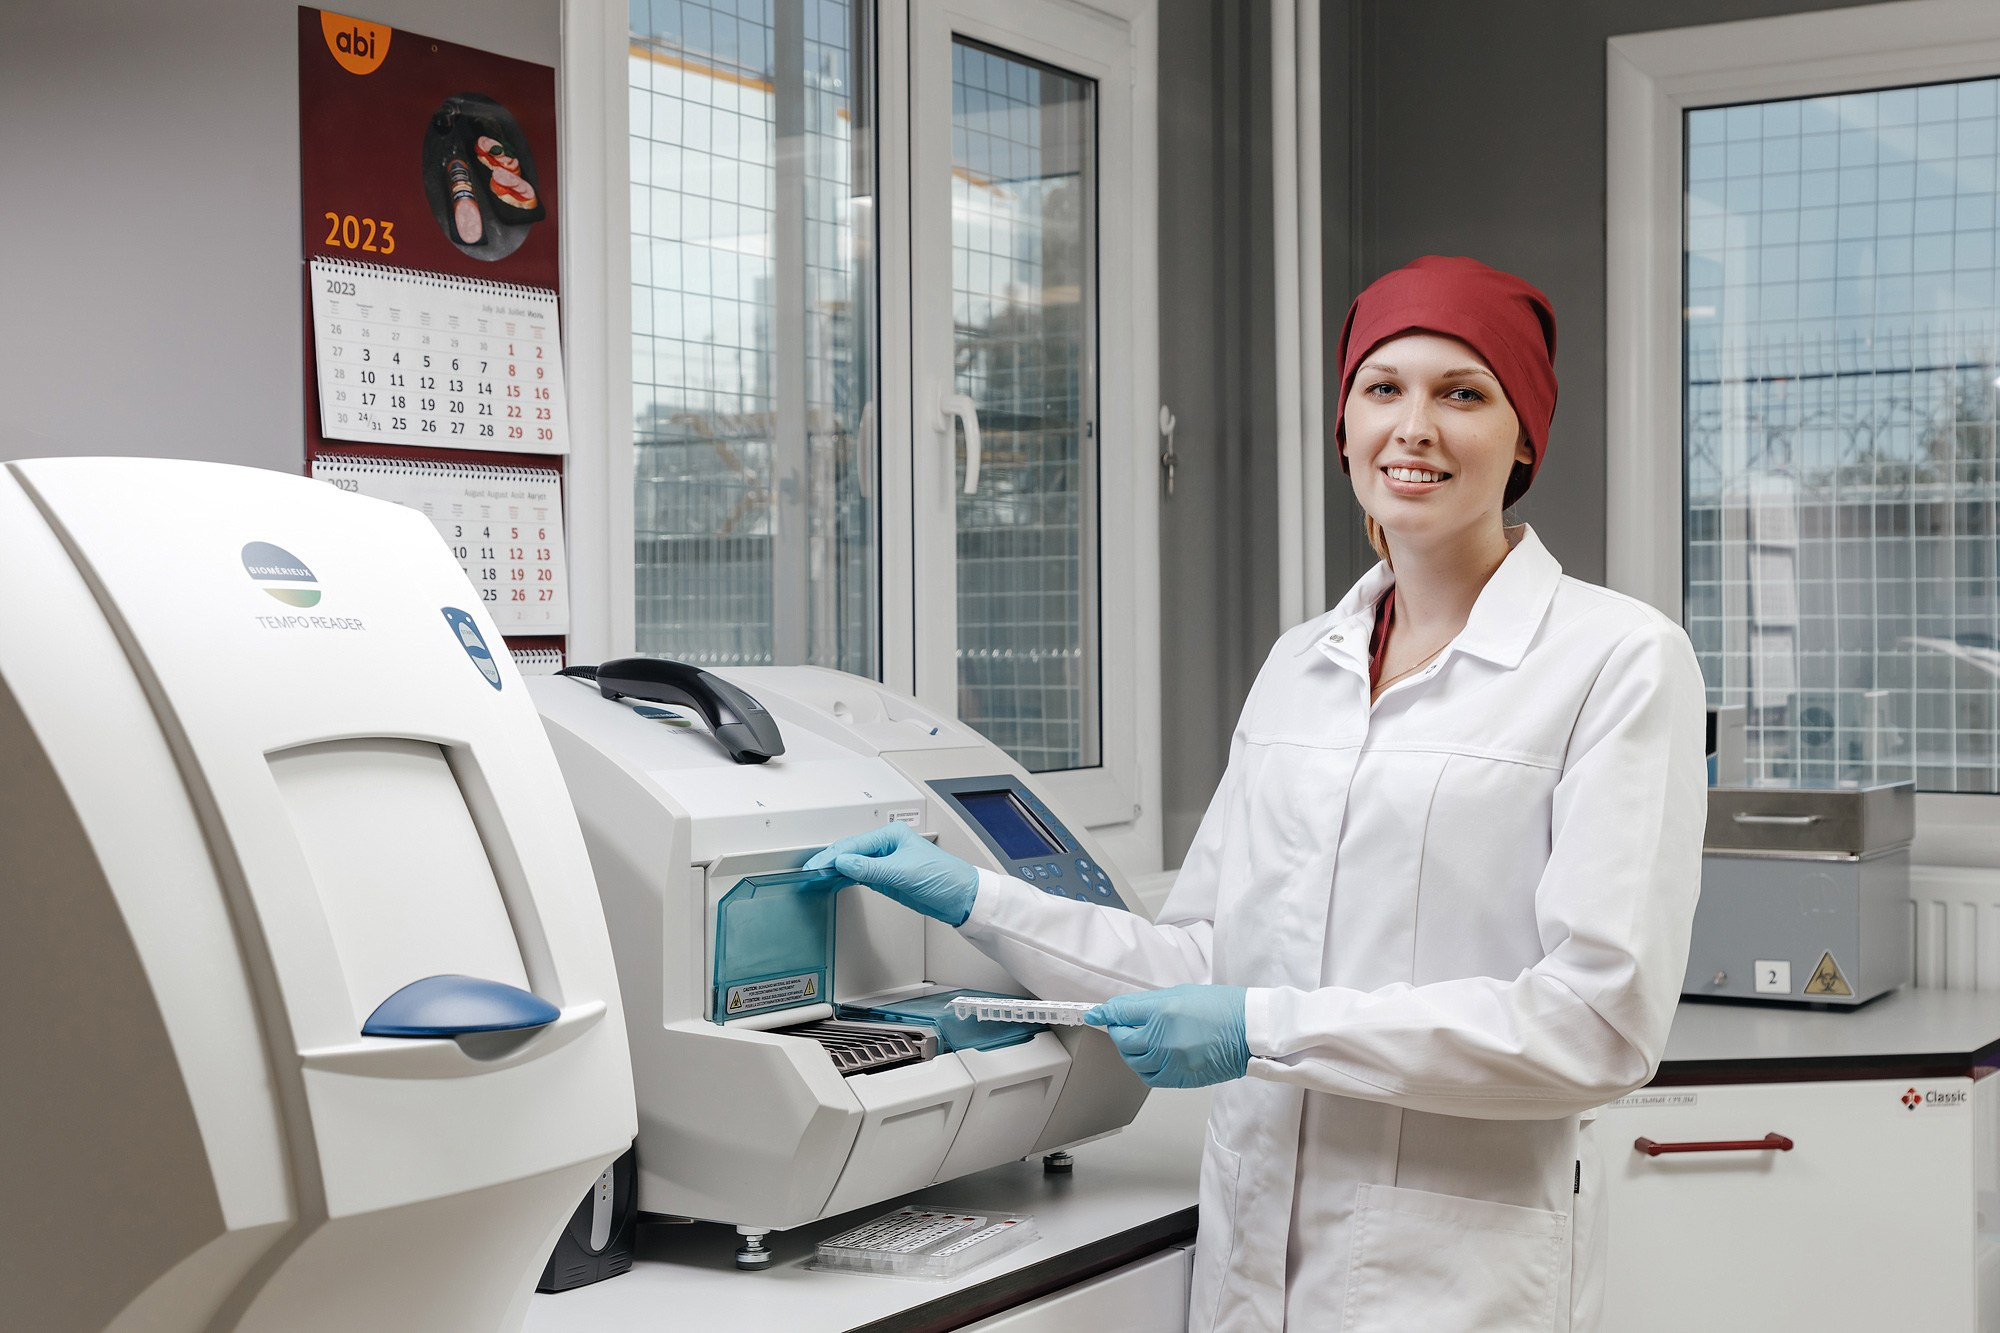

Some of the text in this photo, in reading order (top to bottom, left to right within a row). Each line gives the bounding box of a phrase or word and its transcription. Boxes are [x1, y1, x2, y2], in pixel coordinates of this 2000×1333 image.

[335, 27, 375, 59] abi
[324, 212, 395, 255] 2023
[326, 280, 356, 296] 2023
[330, 324, 343, 335] 26
[508, 344, 515, 357] 1
[535, 347, 543, 359] 2
[332, 346, 544, 380] 27 3 4 5 6 7 8 9
[334, 368, 550, 400] 28 10 11 12 13 14 15 16
[335, 391, 552, 421] 29 17 18 19 20 21 22 23
[337, 413, 349, 424] 30
[391, 417, 407, 431] 25
[421, 420, 437, 433] 26
[450, 422, 465, 435] 27
[479, 424, 494, 437] 28
[508, 426, 523, 439] 29
[537, 428, 553, 441] 30
[455, 526, 546, 541] 3 4 5 6
[452, 547, 551, 561] 10 11 12 13
[248, 565, 312, 578] BIOMÉRIEUX
[482, 569, 497, 581] 18
[511, 569, 525, 581] 19
[537, 569, 553, 581] 20
[482, 589, 554, 602] 25 26 27
[255, 615, 366, 632] TEMPO READER
[1768, 970, 1778, 985] 2
[1925, 1089, 1968, 1103] Classic
